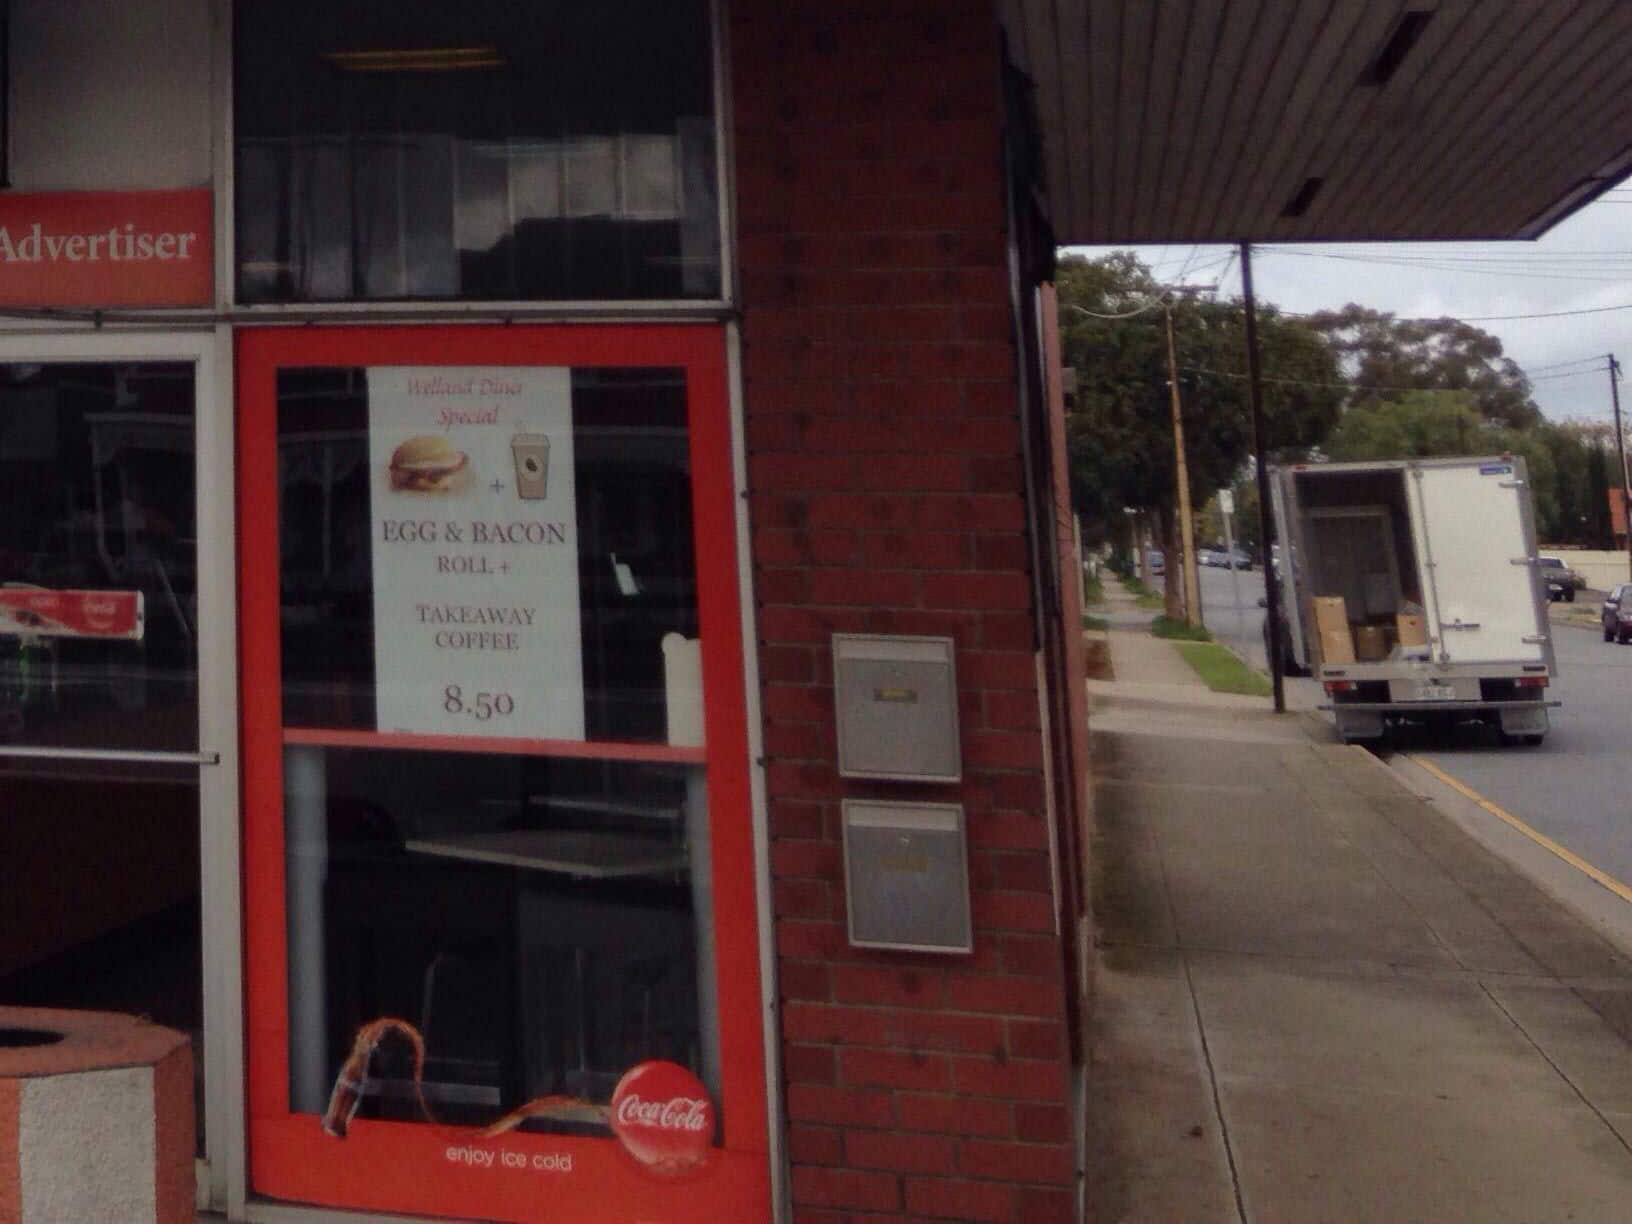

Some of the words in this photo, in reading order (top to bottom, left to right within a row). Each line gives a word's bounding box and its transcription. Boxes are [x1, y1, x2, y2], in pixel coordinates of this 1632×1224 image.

[407, 376, 472, 395] Welland
[479, 378, 523, 396] Diner
[437, 406, 500, 432] Special
[383, 521, 437, 544] EGG
[445, 521, 464, 544] &
[471, 522, 567, 545] BACON
[437, 556, 494, 574] ROLL
[416, 605, 537, 625] TAKEAWAY
[435, 631, 520, 651] COFFEE
[444, 684, 516, 721] 8.50
[445, 1145, 495, 1168] enjoy
[501, 1148, 528, 1168] ice
[532, 1153, 573, 1172] cold
